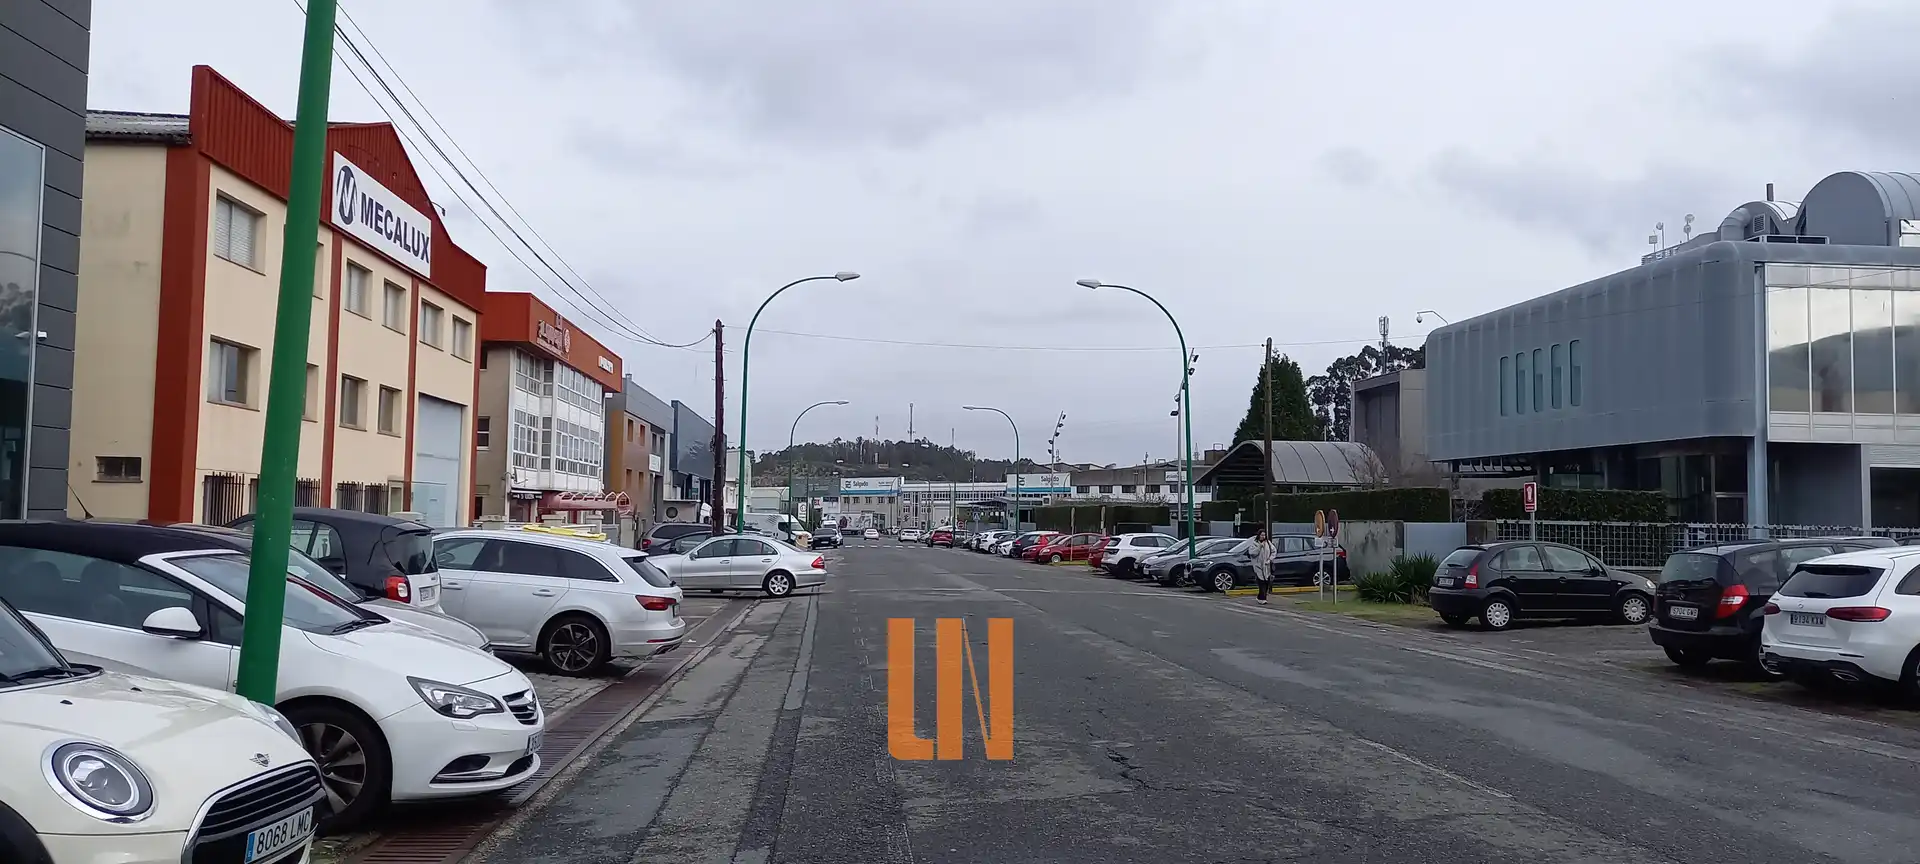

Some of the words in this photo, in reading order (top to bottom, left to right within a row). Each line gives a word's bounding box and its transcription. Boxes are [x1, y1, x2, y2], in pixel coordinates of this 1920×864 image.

[360, 192, 430, 265] MECALUX
[853, 480, 869, 489] Salgado
[1040, 475, 1060, 484] Salgdo
[257, 822, 288, 854] 8068
[290, 811, 310, 839] LMC
